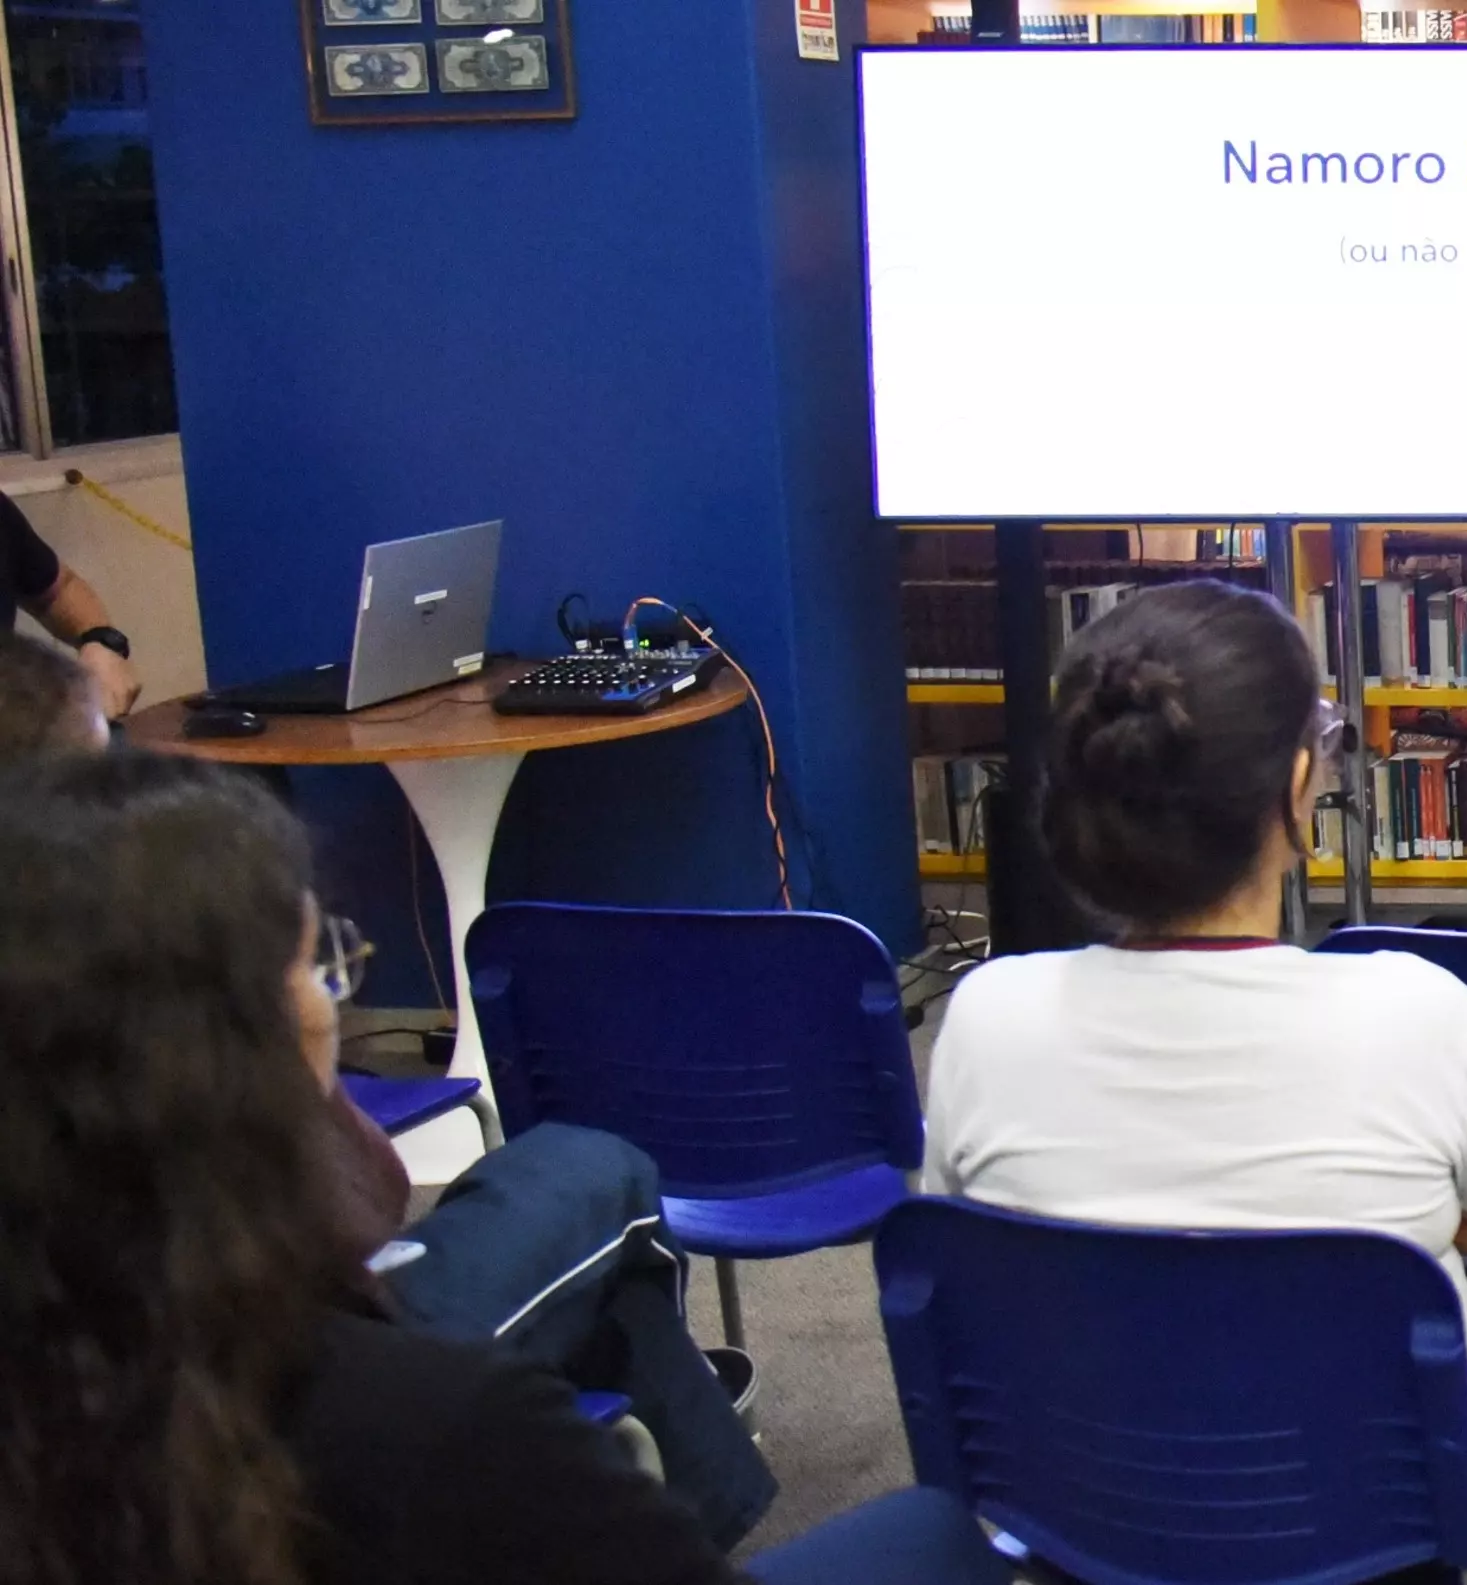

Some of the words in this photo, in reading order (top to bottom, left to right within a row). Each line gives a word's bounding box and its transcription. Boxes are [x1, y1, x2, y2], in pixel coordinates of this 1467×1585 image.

[1222, 139, 1448, 185] Namoro
[1340, 236, 1388, 264] (ou
[1401, 237, 1459, 263] não
